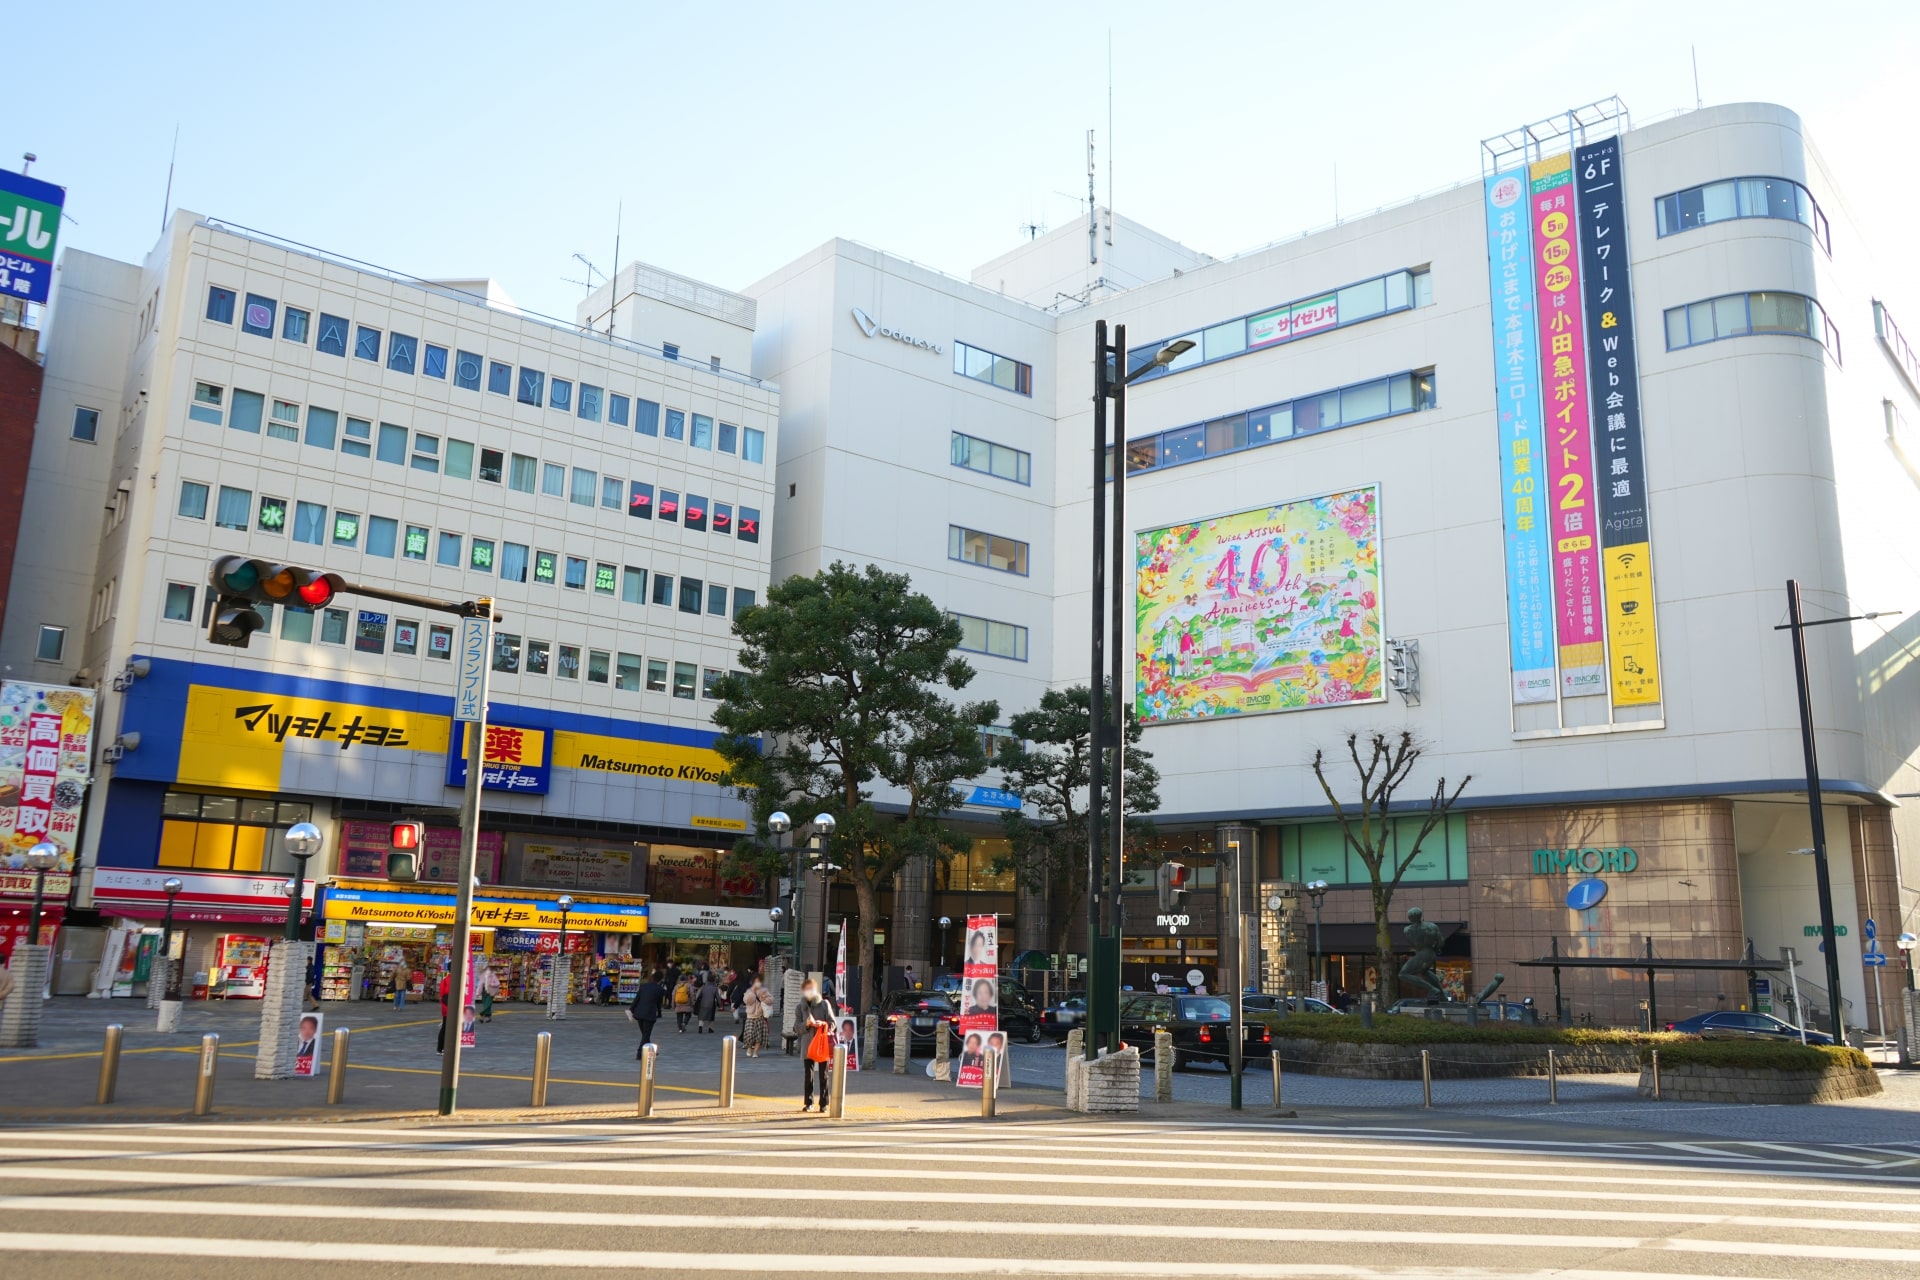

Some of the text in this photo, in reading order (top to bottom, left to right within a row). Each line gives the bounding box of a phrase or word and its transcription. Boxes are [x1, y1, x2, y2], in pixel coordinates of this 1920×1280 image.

[1585, 158, 1611, 180] 6F
[1540, 195, 1565, 212] 毎月
[1547, 220, 1564, 233] 5日
[1545, 245, 1568, 260] 15日
[1546, 271, 1570, 287] 25日
[1278, 305, 1337, 332] サイゼリヤ
[630, 493, 757, 535] アテランス
[1605, 516, 1643, 532] Agora
[1216, 533, 1242, 545] With
[1562, 539, 1588, 549] さらに
[536, 567, 553, 579] 046
[598, 569, 613, 580] 223
[595, 578, 615, 590] 2341
[1201, 594, 1298, 623] Anniversary
[235, 703, 409, 750] マツモトキヨシ
[485, 727, 523, 763] 薬
[501, 764, 522, 772] STORE
[580, 753, 674, 778] Matsumoto
[16, 716, 61, 834] 高価買取
[656, 854, 697, 869] Sweetie
[1533, 847, 1638, 875] MYLORD
[1579, 884, 1591, 905] 1
[351, 907, 456, 920] Matsumoto KiYoshi
[1157, 914, 1190, 926] MYLORD
[594, 918, 628, 928] KiYoshi
[680, 917, 740, 927] KOMESHIN BLDG.
[1804, 925, 1848, 936] MYRD
